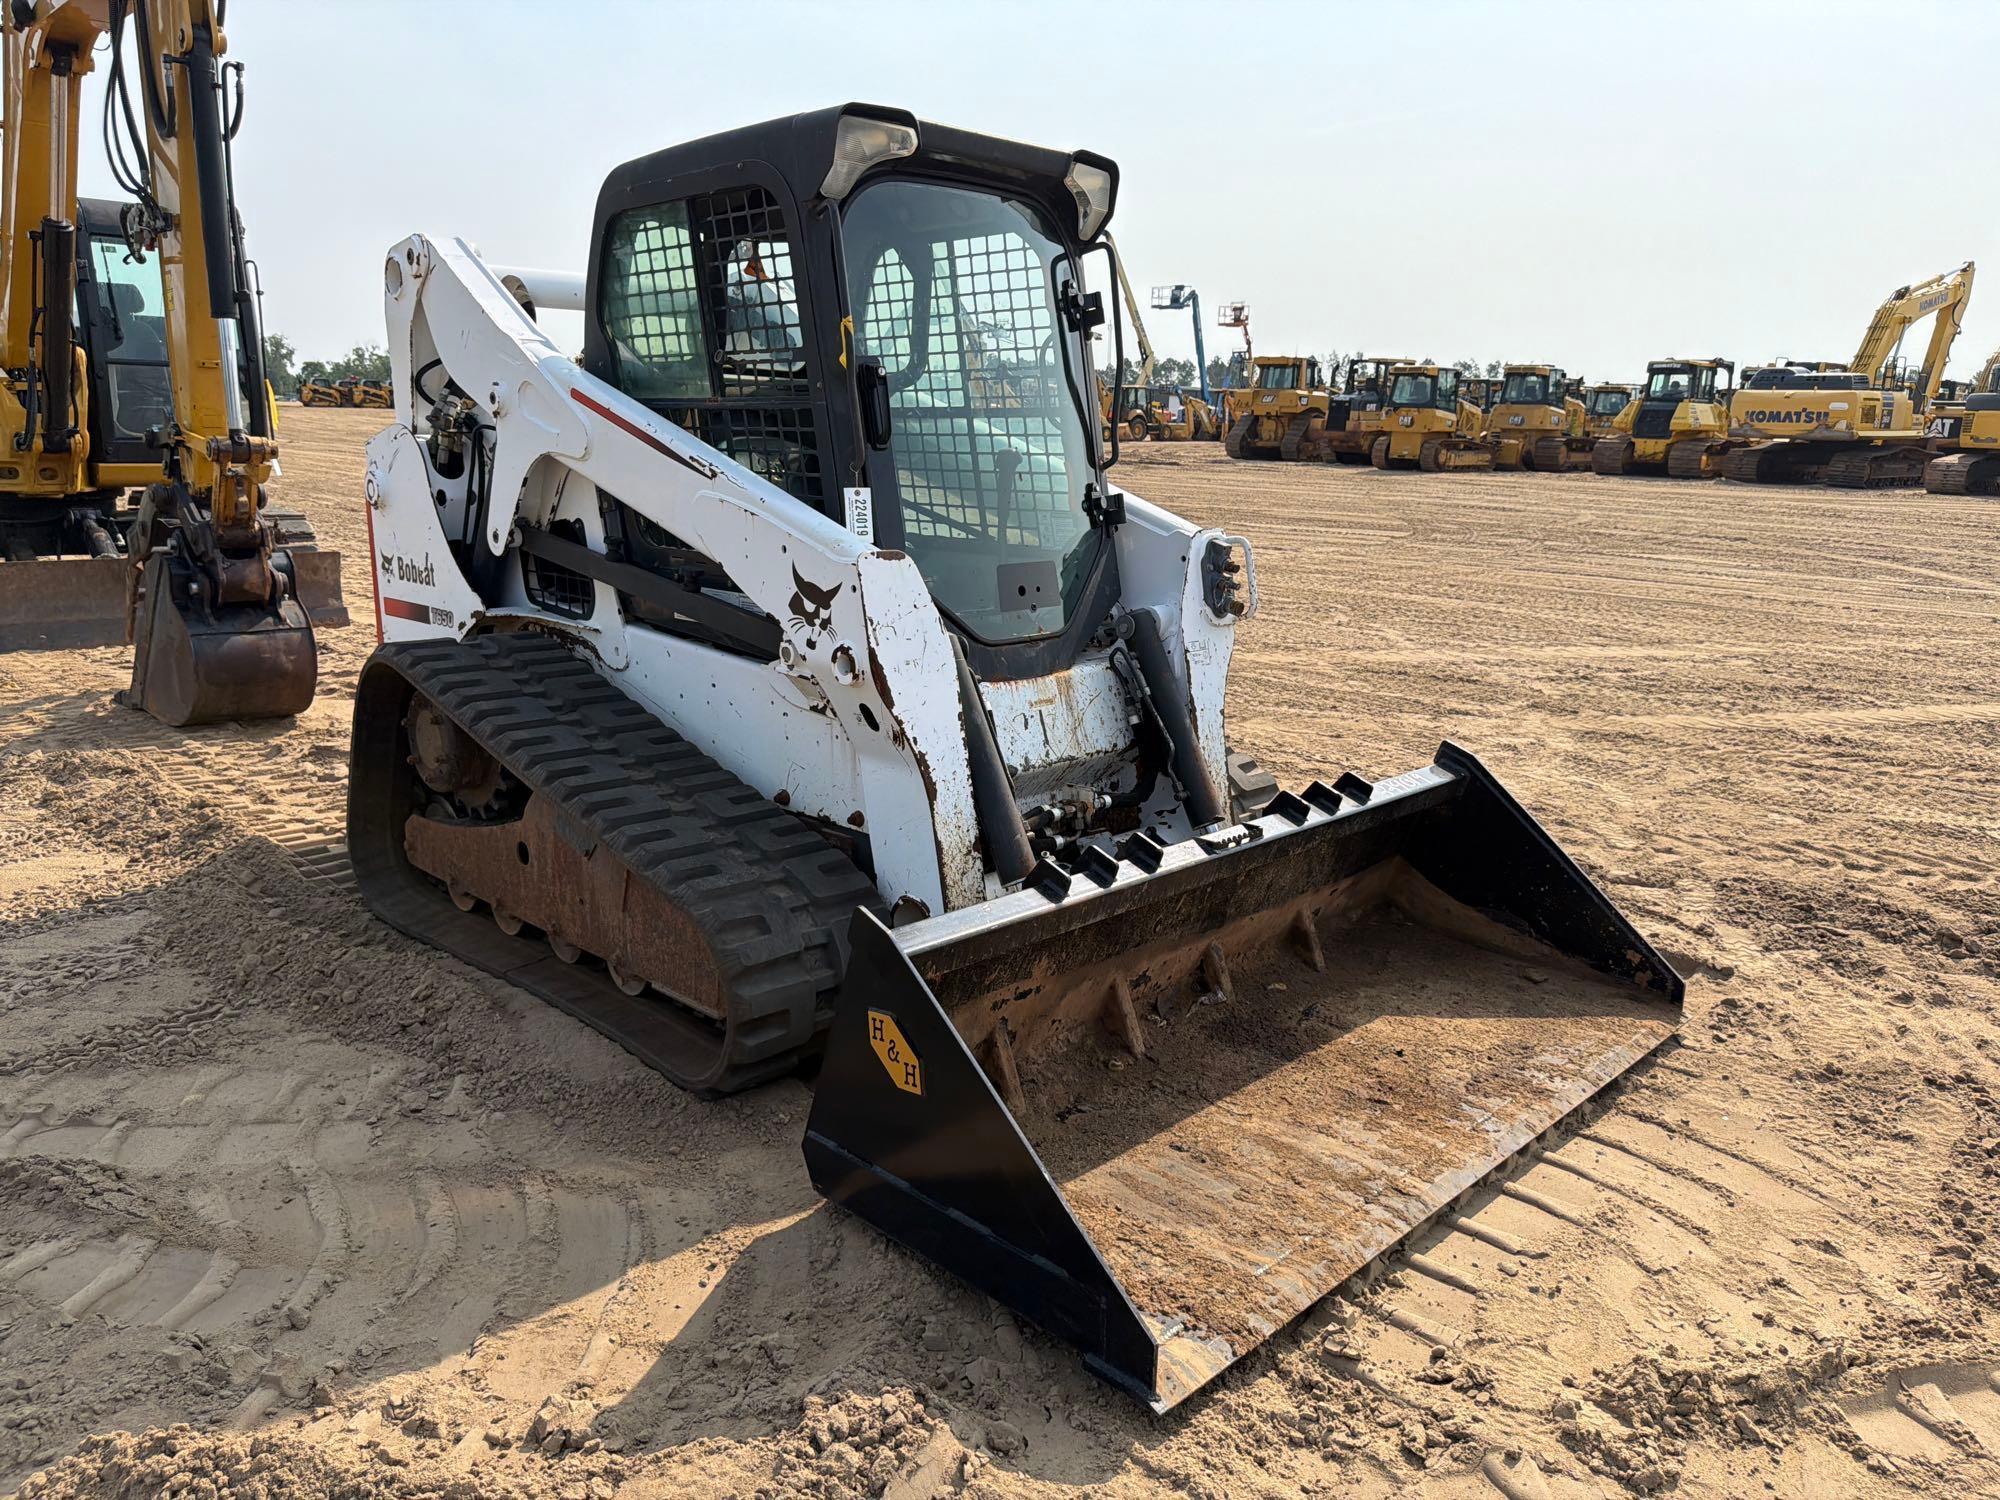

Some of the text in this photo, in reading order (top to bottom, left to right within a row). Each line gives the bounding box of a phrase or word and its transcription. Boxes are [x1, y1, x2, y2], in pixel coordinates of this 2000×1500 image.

[1399, 416, 1412, 425] CAT
[1745, 408, 1829, 423] KOMATSU
[855, 499, 868, 536] 224019
[397, 554, 435, 587] Bobcat
[431, 607, 454, 628] T650
[871, 1017, 917, 1088] H & H
